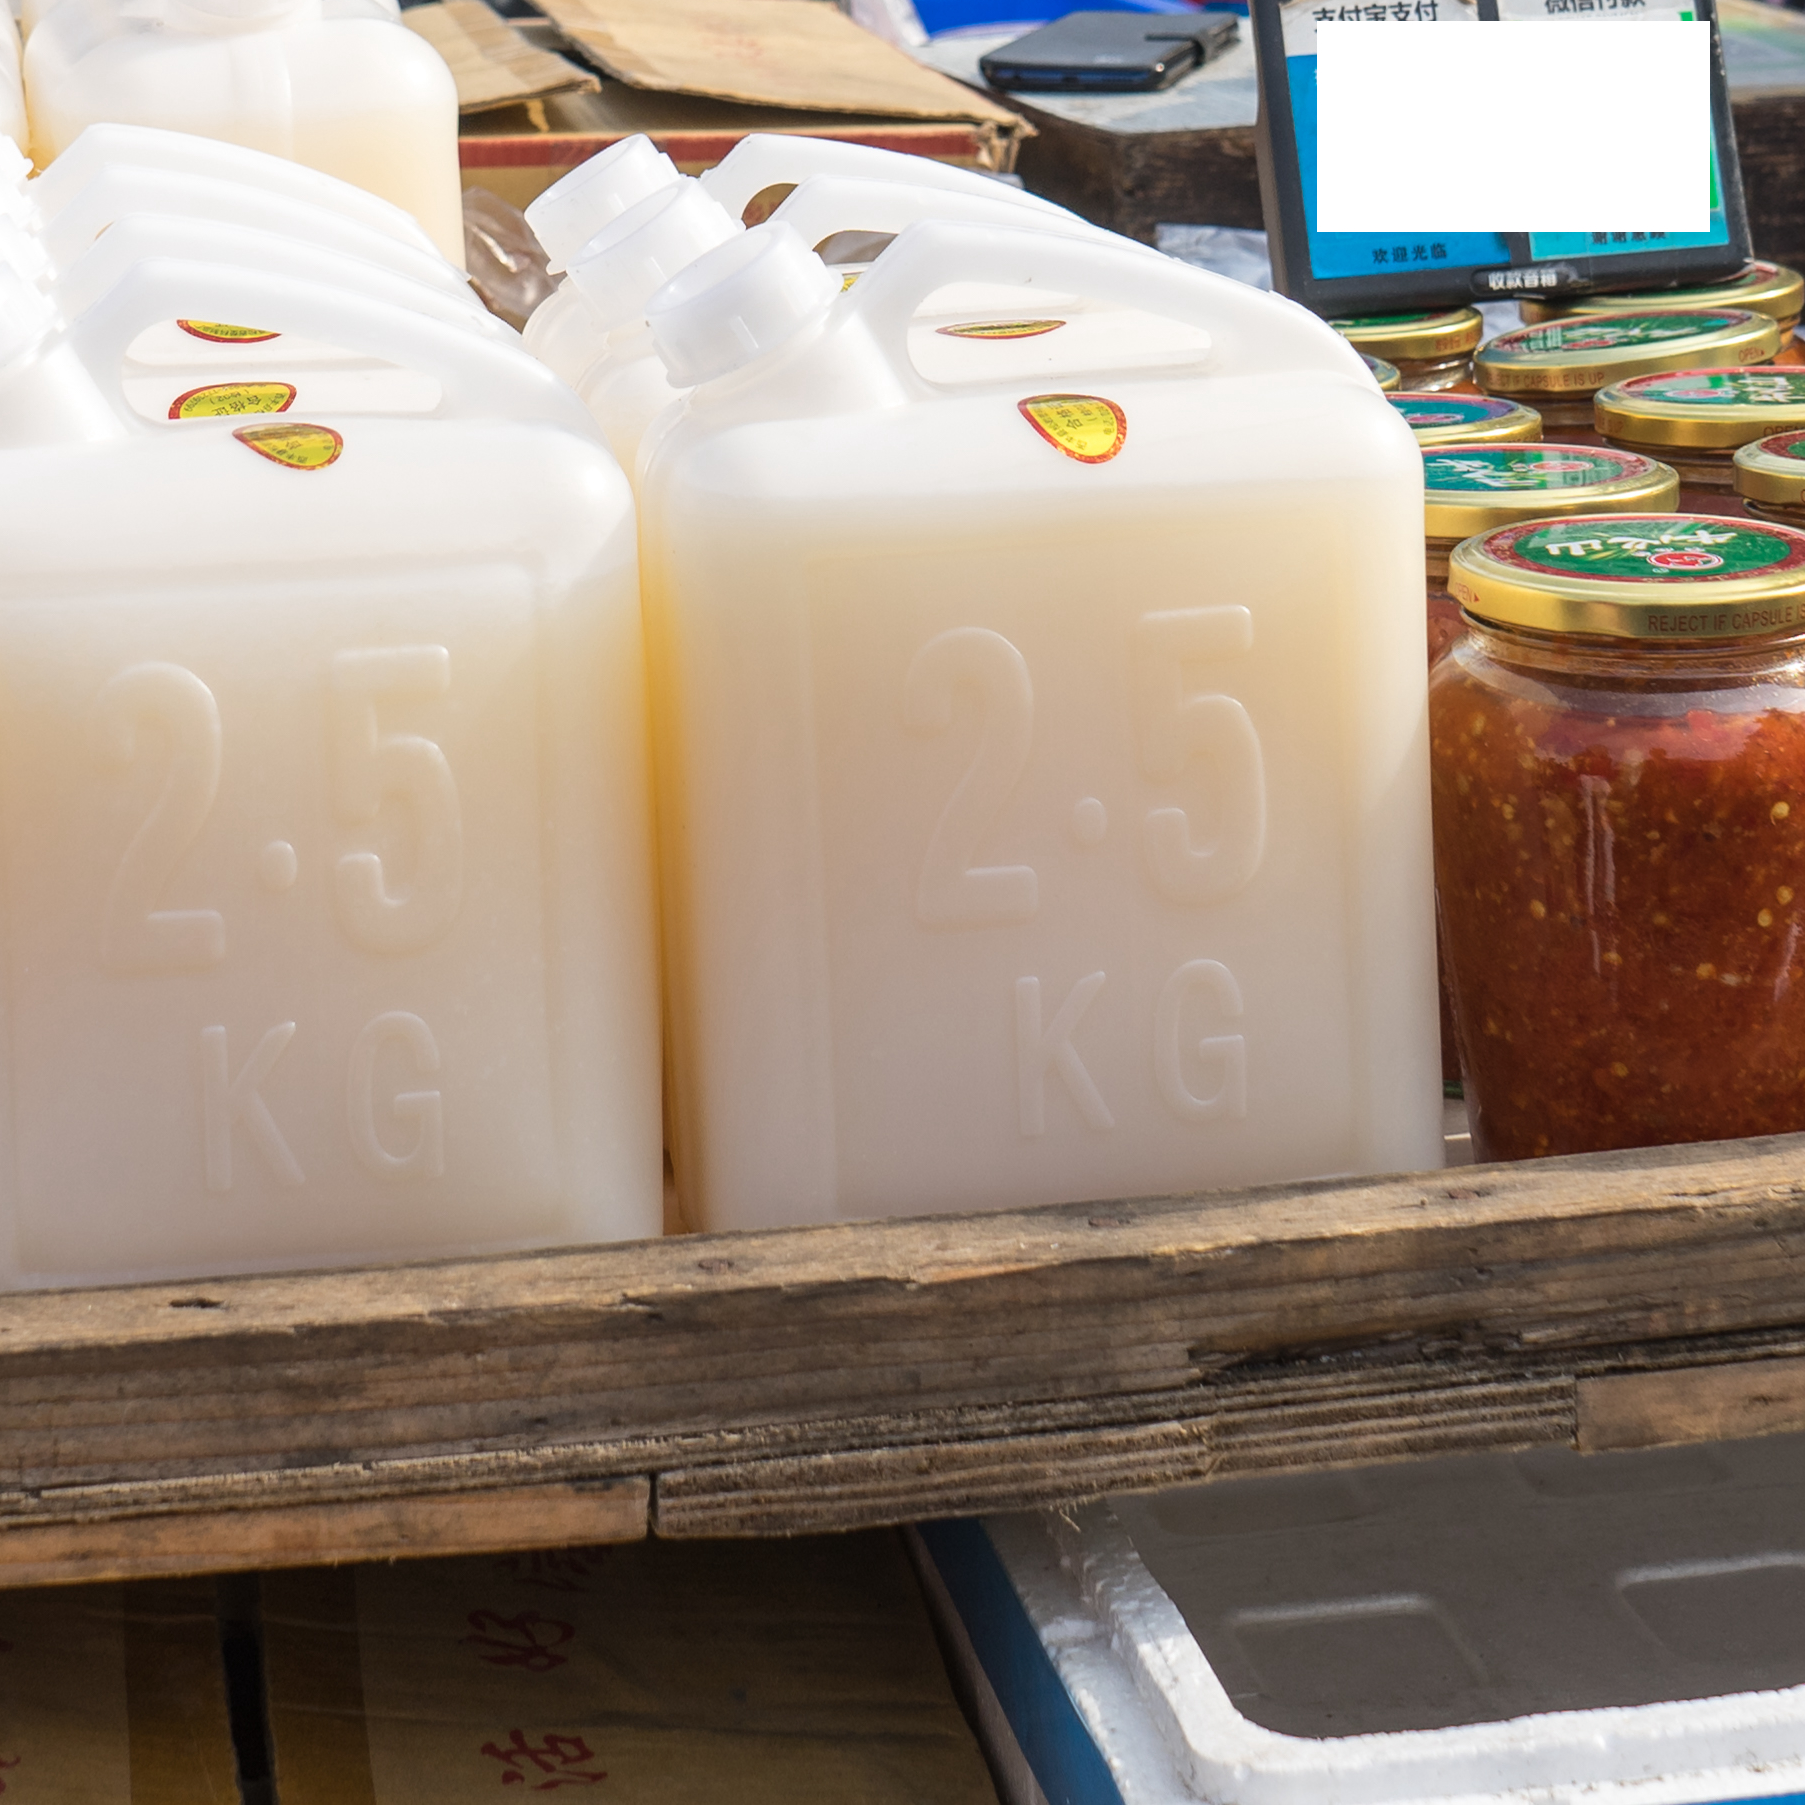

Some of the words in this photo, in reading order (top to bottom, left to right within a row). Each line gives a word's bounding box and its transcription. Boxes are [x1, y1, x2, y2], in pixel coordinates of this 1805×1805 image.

[1371, 242, 1448, 265] 欢迎光临
[1487, 269, 1558, 290] 收款音箱
[1523, 370, 1571, 388] CAPSULE
[1573, 372, 1585, 387] IS
[1589, 371, 1606, 385] UP
[1647, 612, 1709, 632] REJECT
[1713, 611, 1728, 629] IF
[1731, 605, 1793, 630] CAPSULE
[98, 640, 462, 973] 2.5
[904, 601, 1269, 927] 2.5
[1013, 956, 1250, 1139] KG
[198, 1009, 448, 1193] KG
